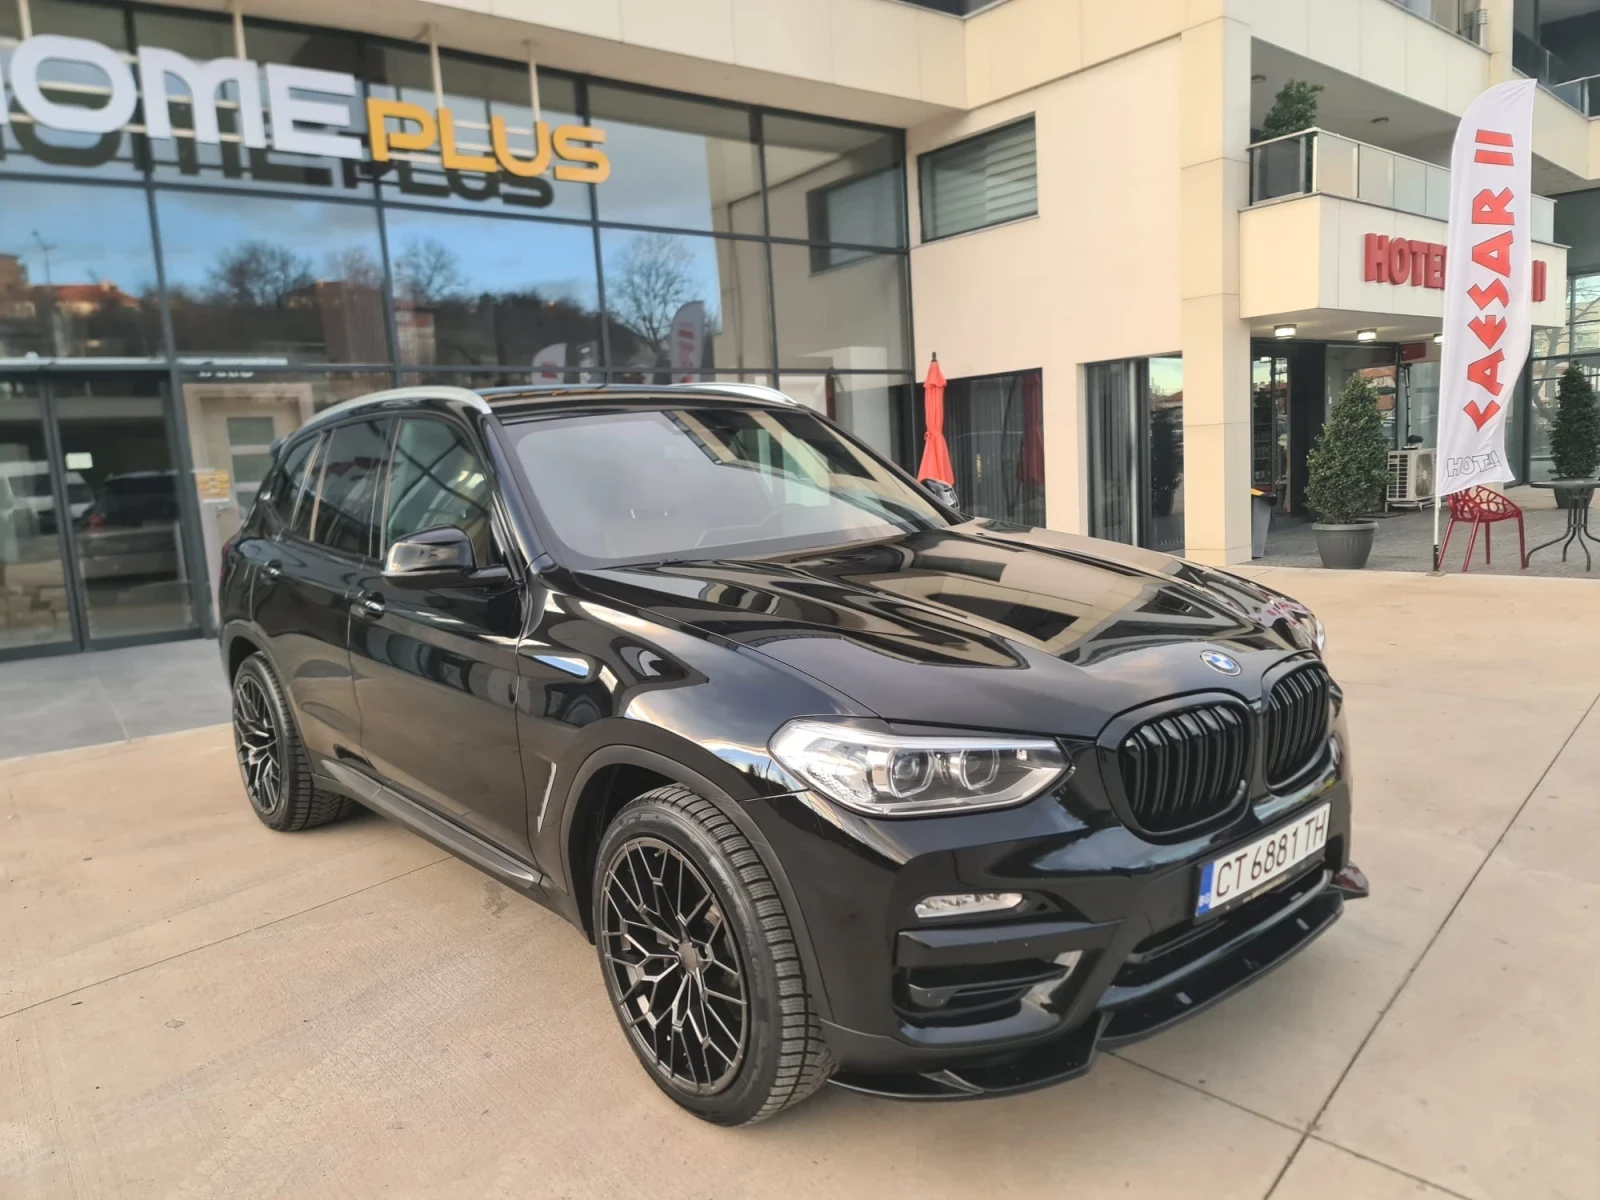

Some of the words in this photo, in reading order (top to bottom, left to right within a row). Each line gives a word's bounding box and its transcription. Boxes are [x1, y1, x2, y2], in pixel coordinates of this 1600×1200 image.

[0, 34, 362, 160] OME
[366, 97, 611, 184] PLUS
[1364, 233, 1447, 290] HOTE
[1463, 187, 1515, 432] CAESAR
[1216, 853, 1248, 897] CT
[1251, 826, 1299, 881] 6881
[1305, 811, 1327, 853] TH
